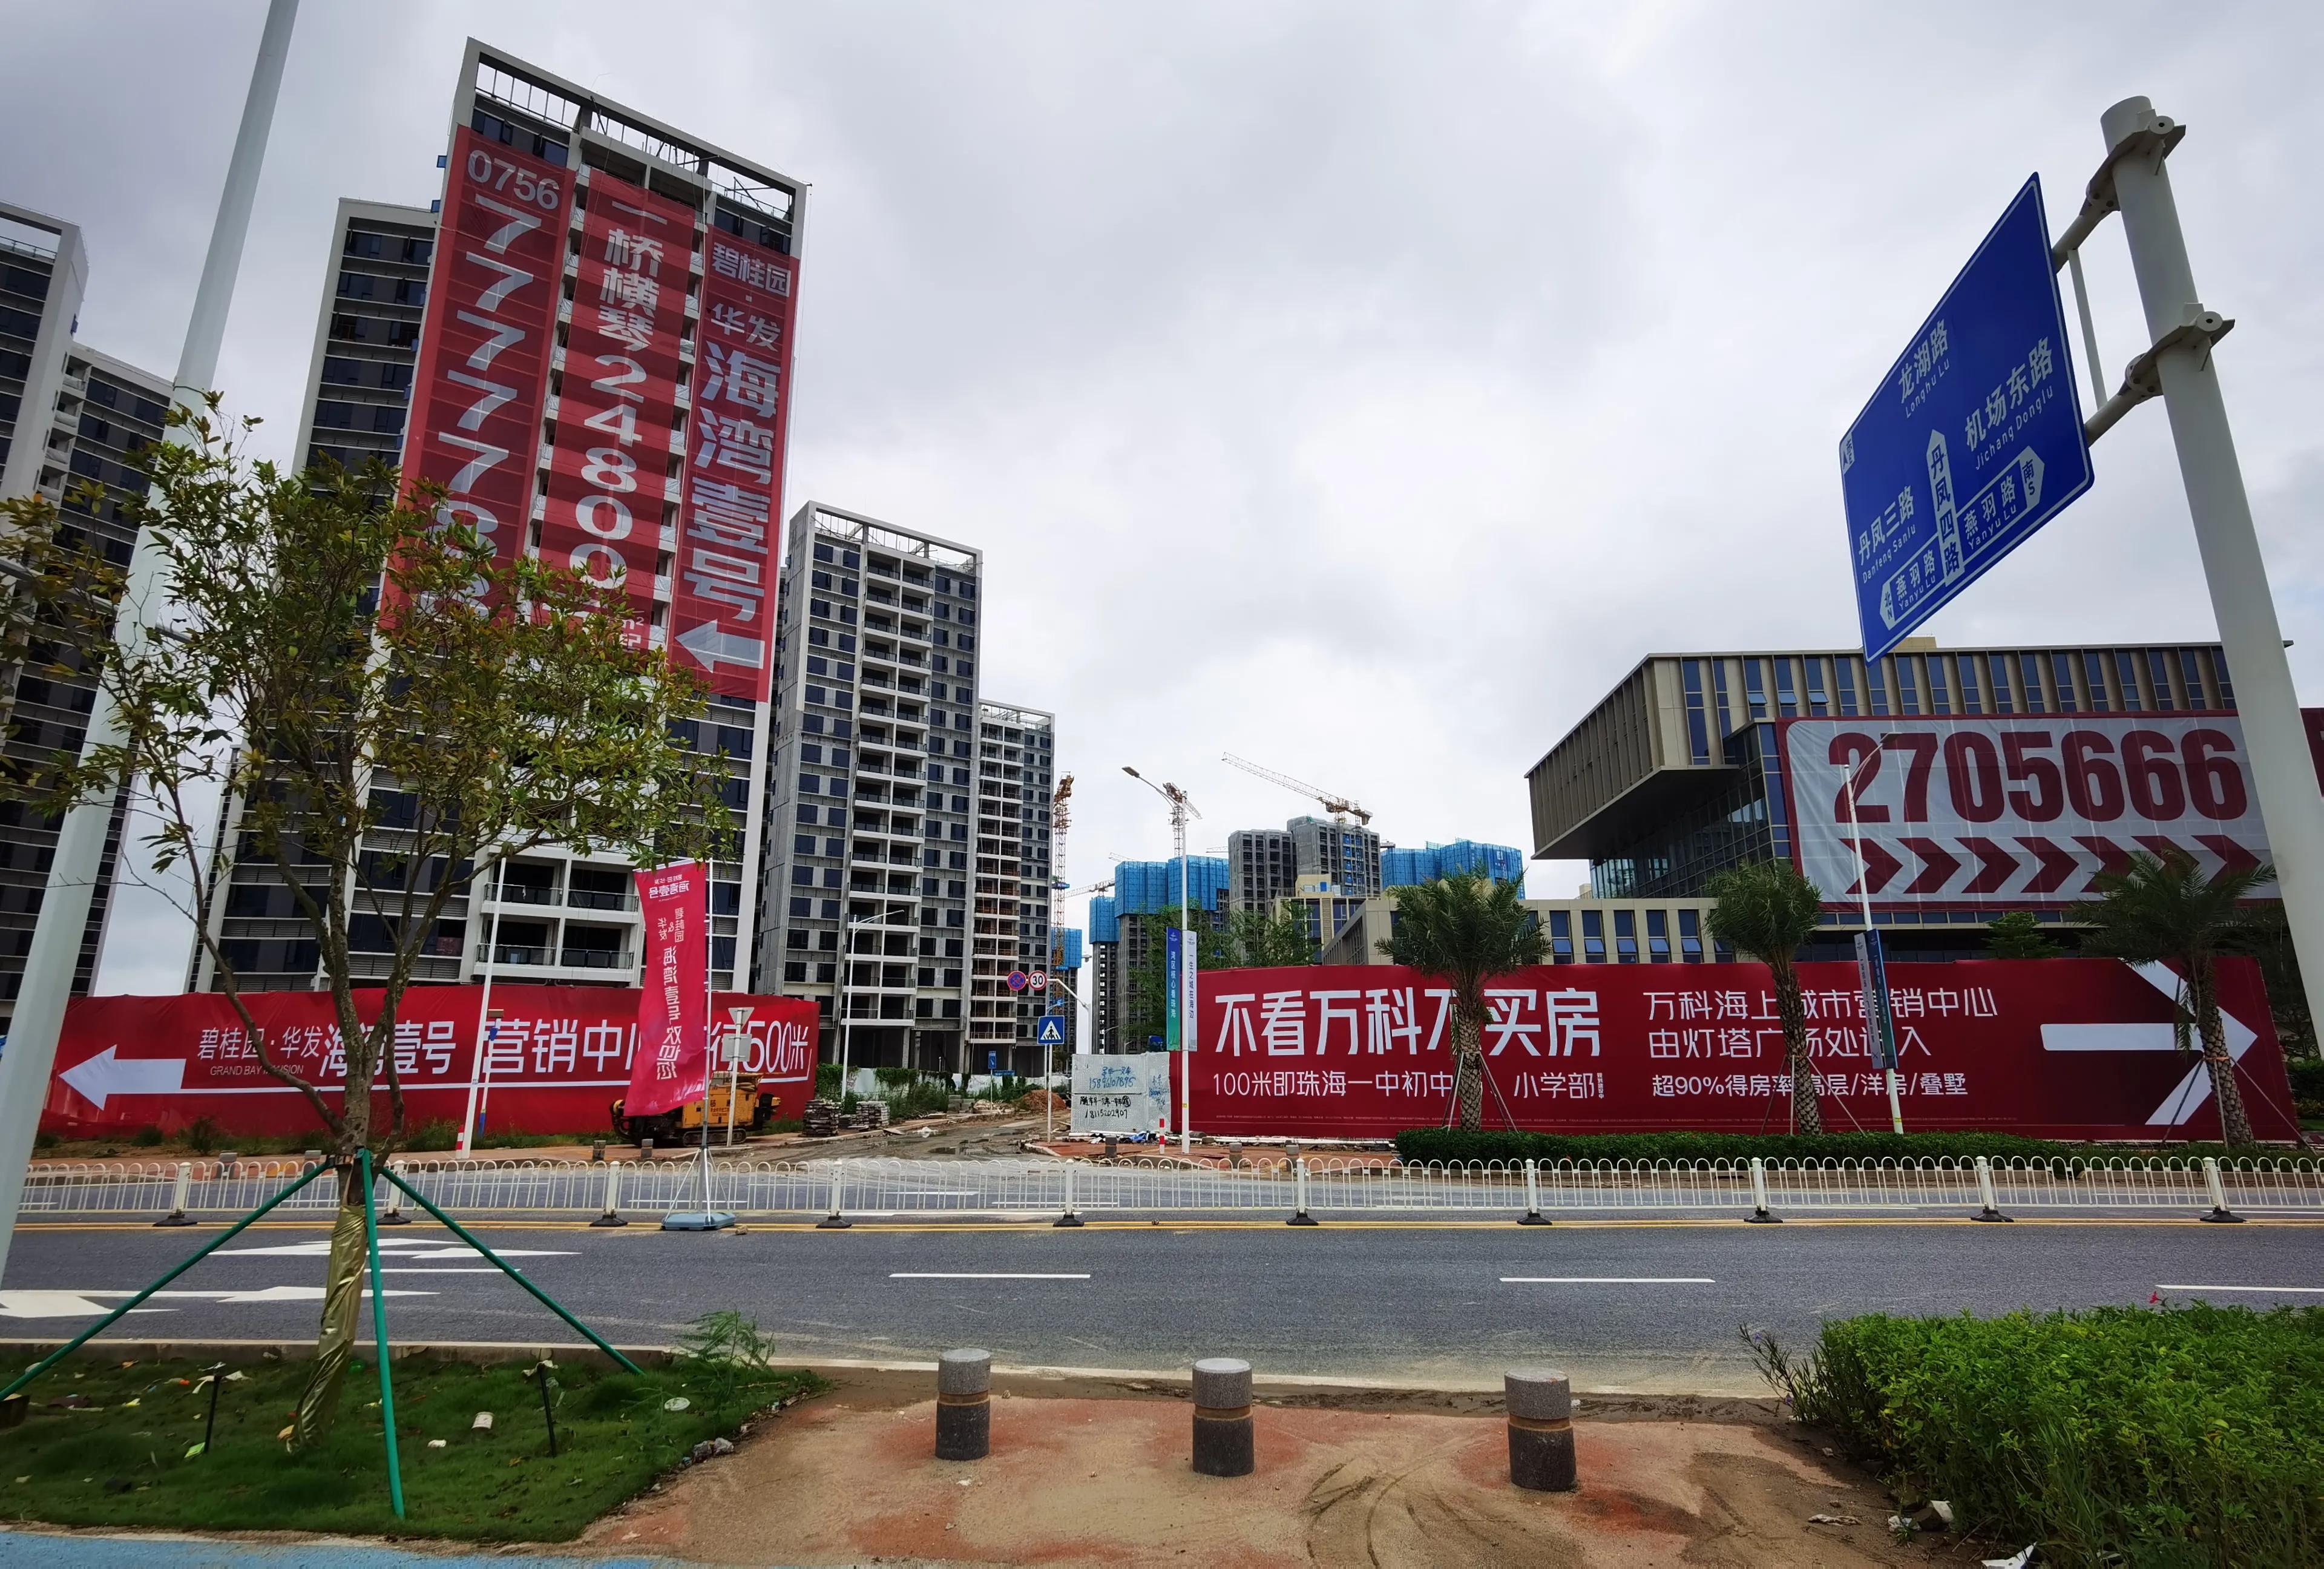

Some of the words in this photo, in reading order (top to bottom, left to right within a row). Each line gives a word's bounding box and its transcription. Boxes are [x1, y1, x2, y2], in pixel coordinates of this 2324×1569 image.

[468, 150, 560, 210] 0756
[1899, 319, 1948, 404] 龙湖路
[1906, 377, 1937, 418] Longhu
[1938, 358, 1950, 378] Lu
[1965, 337, 2053, 452] 机场东路
[1975, 426, 2014, 470] Jichang
[2015, 386, 2053, 430] Donglu
[684, 340, 781, 622] 海湾壹号
[2021, 459, 2034, 484] 南
[2028, 481, 2035, 496] S
[1859, 485, 1914, 566] 丹凤三路
[1931, 444, 1960, 575] 丹凤四路
[1964, 475, 2015, 540] 燕羽路
[1968, 518, 2001, 550] Yanyu
[2004, 504, 2017, 521] Lu
[1892, 524, 1916, 552] Sanlu
[1884, 591, 1892, 606] 北
[1896, 549, 1935, 599] 燕羽路
[1899, 585, 1924, 611] Yanyu
[1925, 574, 1936, 589] Lu
[1886, 607, 1893, 620] N
[1828, 729, 2248, 823] 2705666
[1032, 975, 1043, 985] 30
[210, 1065, 242, 1076] GRAND
[244, 1065, 262, 1076] BAY
[263, 1065, 304, 1075] SION
